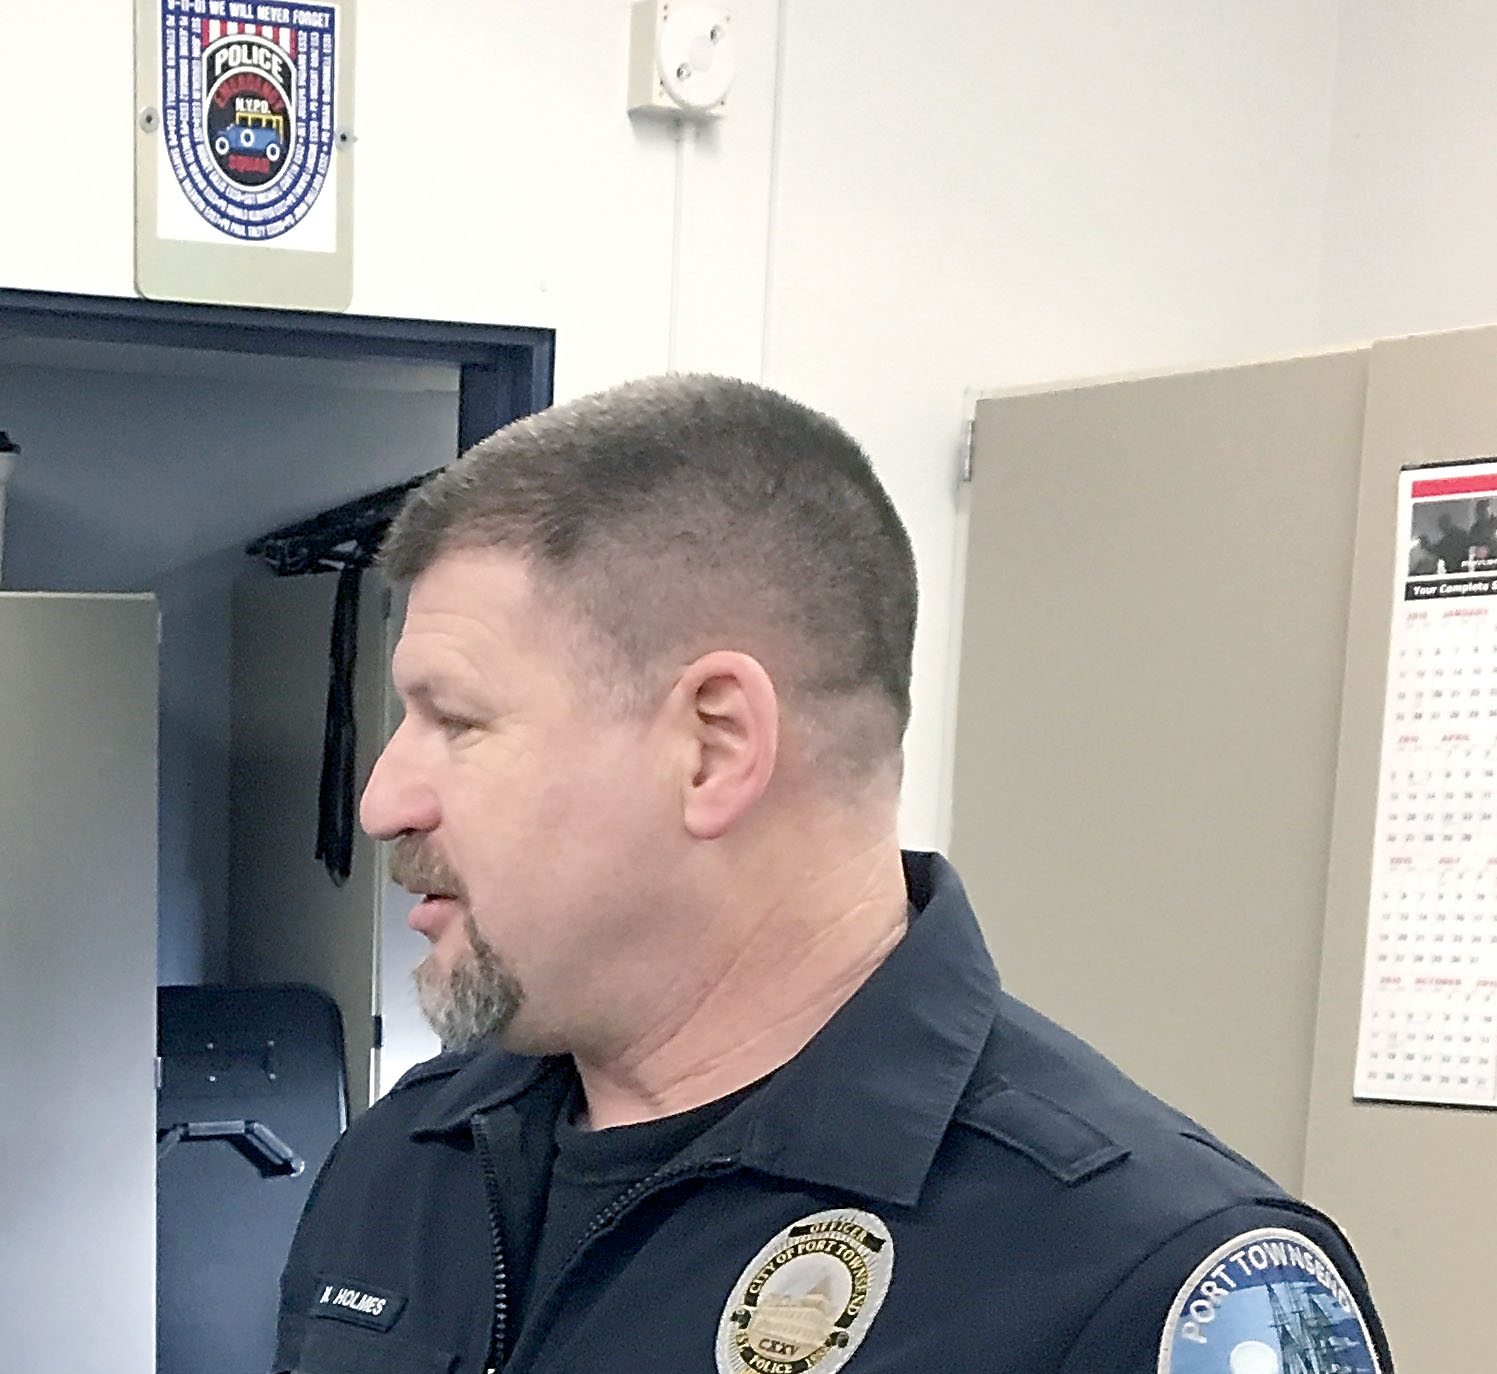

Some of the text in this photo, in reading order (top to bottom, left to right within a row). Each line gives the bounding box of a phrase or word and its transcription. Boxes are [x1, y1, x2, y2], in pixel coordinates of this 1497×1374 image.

[209, 1, 226, 15] WE
[229, 2, 254, 19] WILL
[256, 5, 290, 23] NEVER
[292, 9, 330, 28] FORGET
[215, 44, 284, 84] POLICE
[1413, 585, 1438, 596] Your
[1439, 582, 1490, 594] Complete
[809, 1221, 868, 1241] OFFICER
[749, 1239, 870, 1317] CITY OF PORT TOWNSEND
[332, 1287, 387, 1316] HOLMES
[1181, 1240, 1351, 1345] PORT TOWNSEND
[749, 1354, 793, 1374] POLICE
